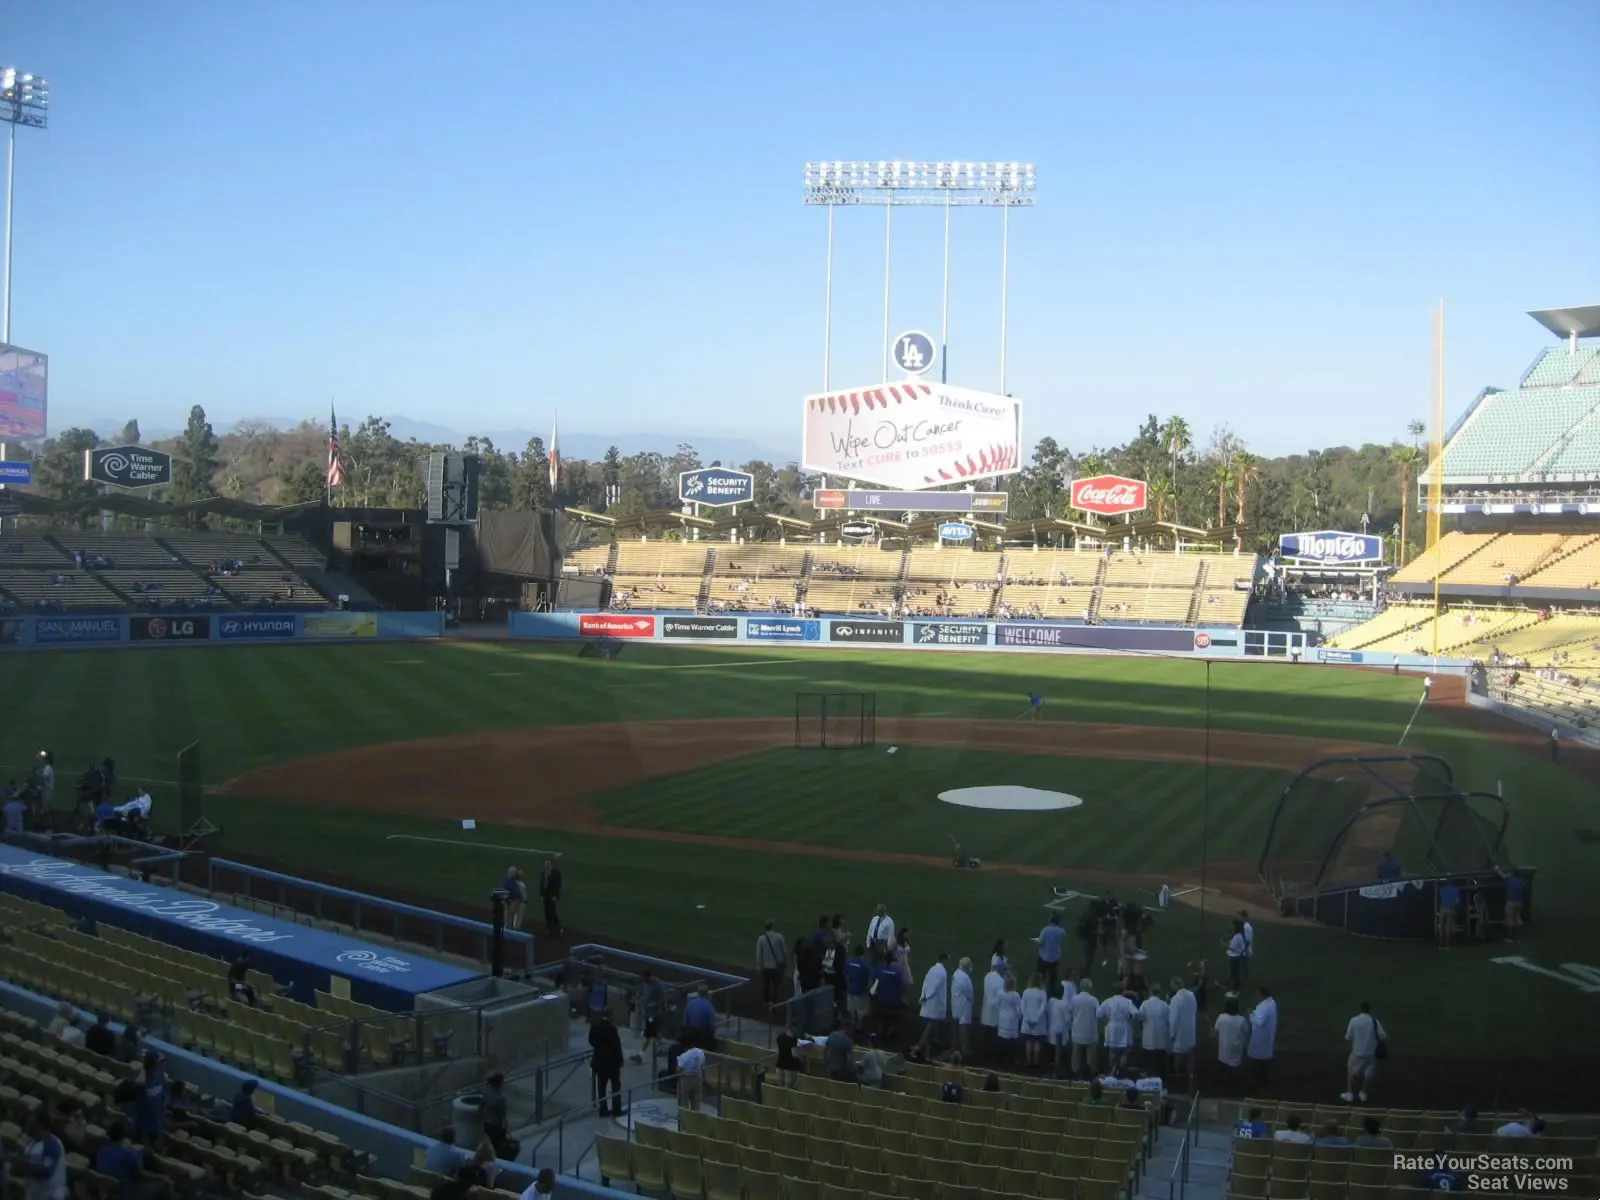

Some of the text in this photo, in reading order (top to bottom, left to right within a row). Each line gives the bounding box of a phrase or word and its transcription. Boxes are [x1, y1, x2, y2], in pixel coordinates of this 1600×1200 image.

[902, 338, 925, 367] LA
[938, 394, 1007, 417] ThinkCure!
[831, 417, 963, 459] Wipe Out Cancer
[129, 453, 154, 463] Time
[837, 459, 865, 472] Text
[866, 450, 902, 467] CURE
[906, 448, 919, 460] to
[130, 462, 163, 472] Warner
[130, 471, 155, 480] Cable
[707, 477, 749, 486] SECURITY
[707, 486, 744, 495] BENEFIT
[1077, 484, 1140, 505] Coca-Cola
[1297, 535, 1366, 559] Montejo
[38, 620, 119, 632] SAN MANUEL
[172, 620, 195, 635] LG
[243, 621, 295, 632] HYUNDAI
[583, 621, 634, 631] Bank of America
[674, 623, 737, 632] Time Warner Cable
[761, 624, 801, 634] Merrill Lynch
[939, 624, 983, 634] SECURITY
[855, 628, 899, 636] INFINITI
[1004, 628, 1062, 646] WELCOME
[939, 634, 979, 644] BENEFIT
